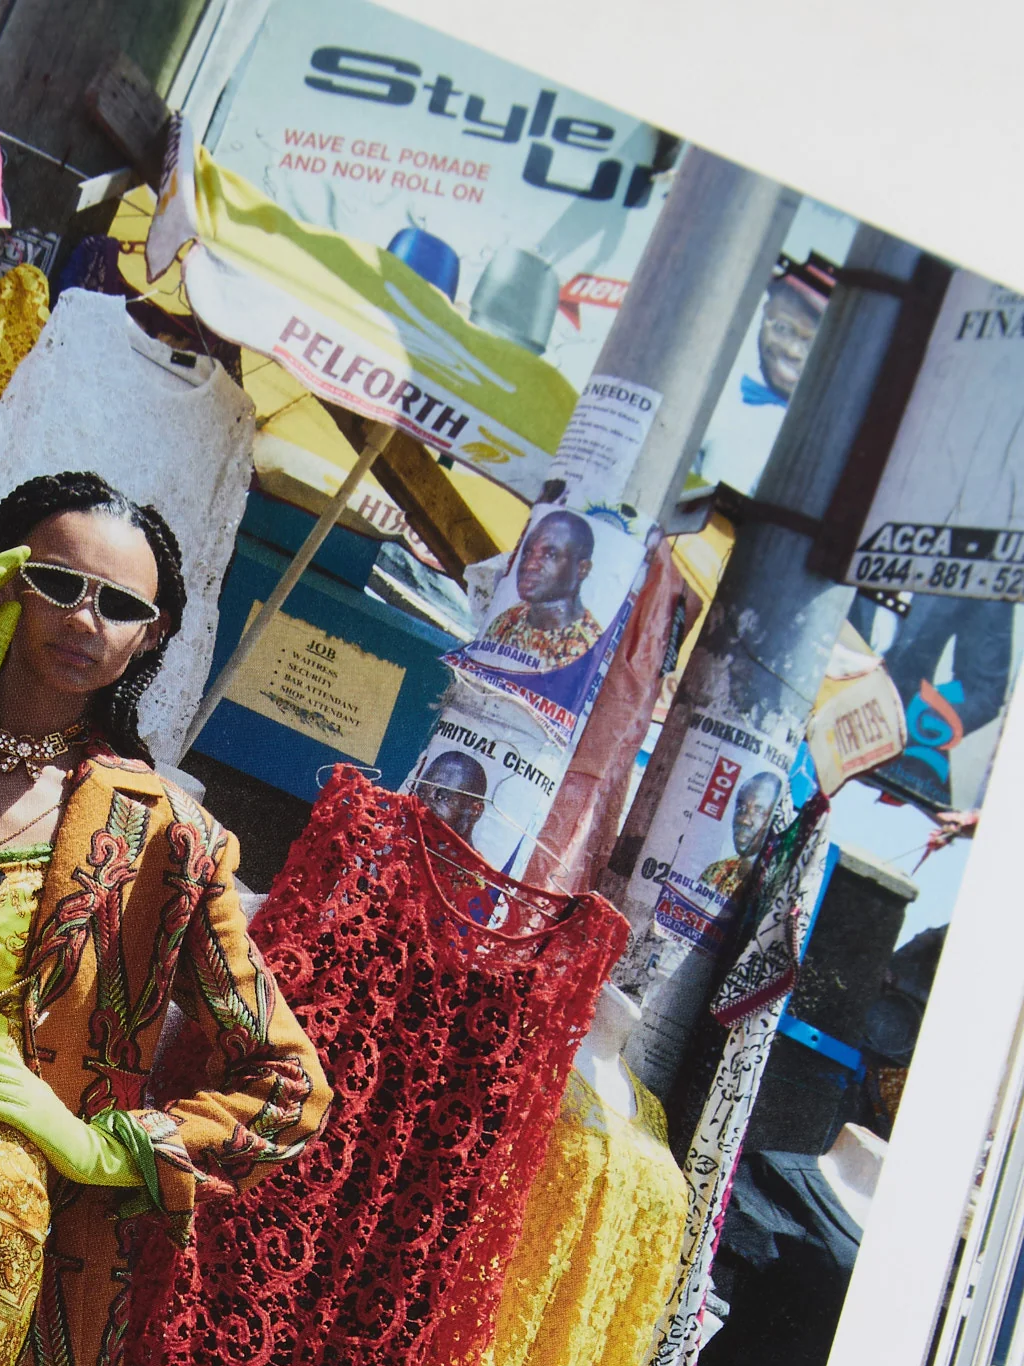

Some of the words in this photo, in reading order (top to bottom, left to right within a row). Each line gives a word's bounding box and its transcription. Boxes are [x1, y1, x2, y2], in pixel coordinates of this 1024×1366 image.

[304, 45, 616, 153] Style
[284, 128, 346, 153] WAVE
[350, 139, 391, 162] GEL
[398, 147, 491, 181] POMADE
[279, 152, 327, 174] AND
[332, 160, 386, 184] NOW
[391, 170, 446, 196] ROLL
[452, 183, 485, 204] ON
[278, 315, 470, 440] PELFORTH
[590, 383, 653, 412] NEEDED
[869, 524, 952, 558] ACCA
[856, 555, 913, 585] 0244
[928, 560, 974, 590] 881
[292, 650, 338, 678] WAITRESS
[305, 639, 337, 660] JOB
[495, 644, 542, 670] BOAHEN
[284, 673, 303, 689] BAR
[305, 684, 359, 714] ATTENDANT
[288, 662, 332, 689] SECURITY
[280, 684, 305, 700] SHOP
[307, 698, 361, 727] ATTENDANT
[688, 711, 764, 755] WORKERS
[502, 751, 556, 797] CENTRE
[703, 760, 737, 817] VOTE
[668, 870, 695, 892] PAUL
